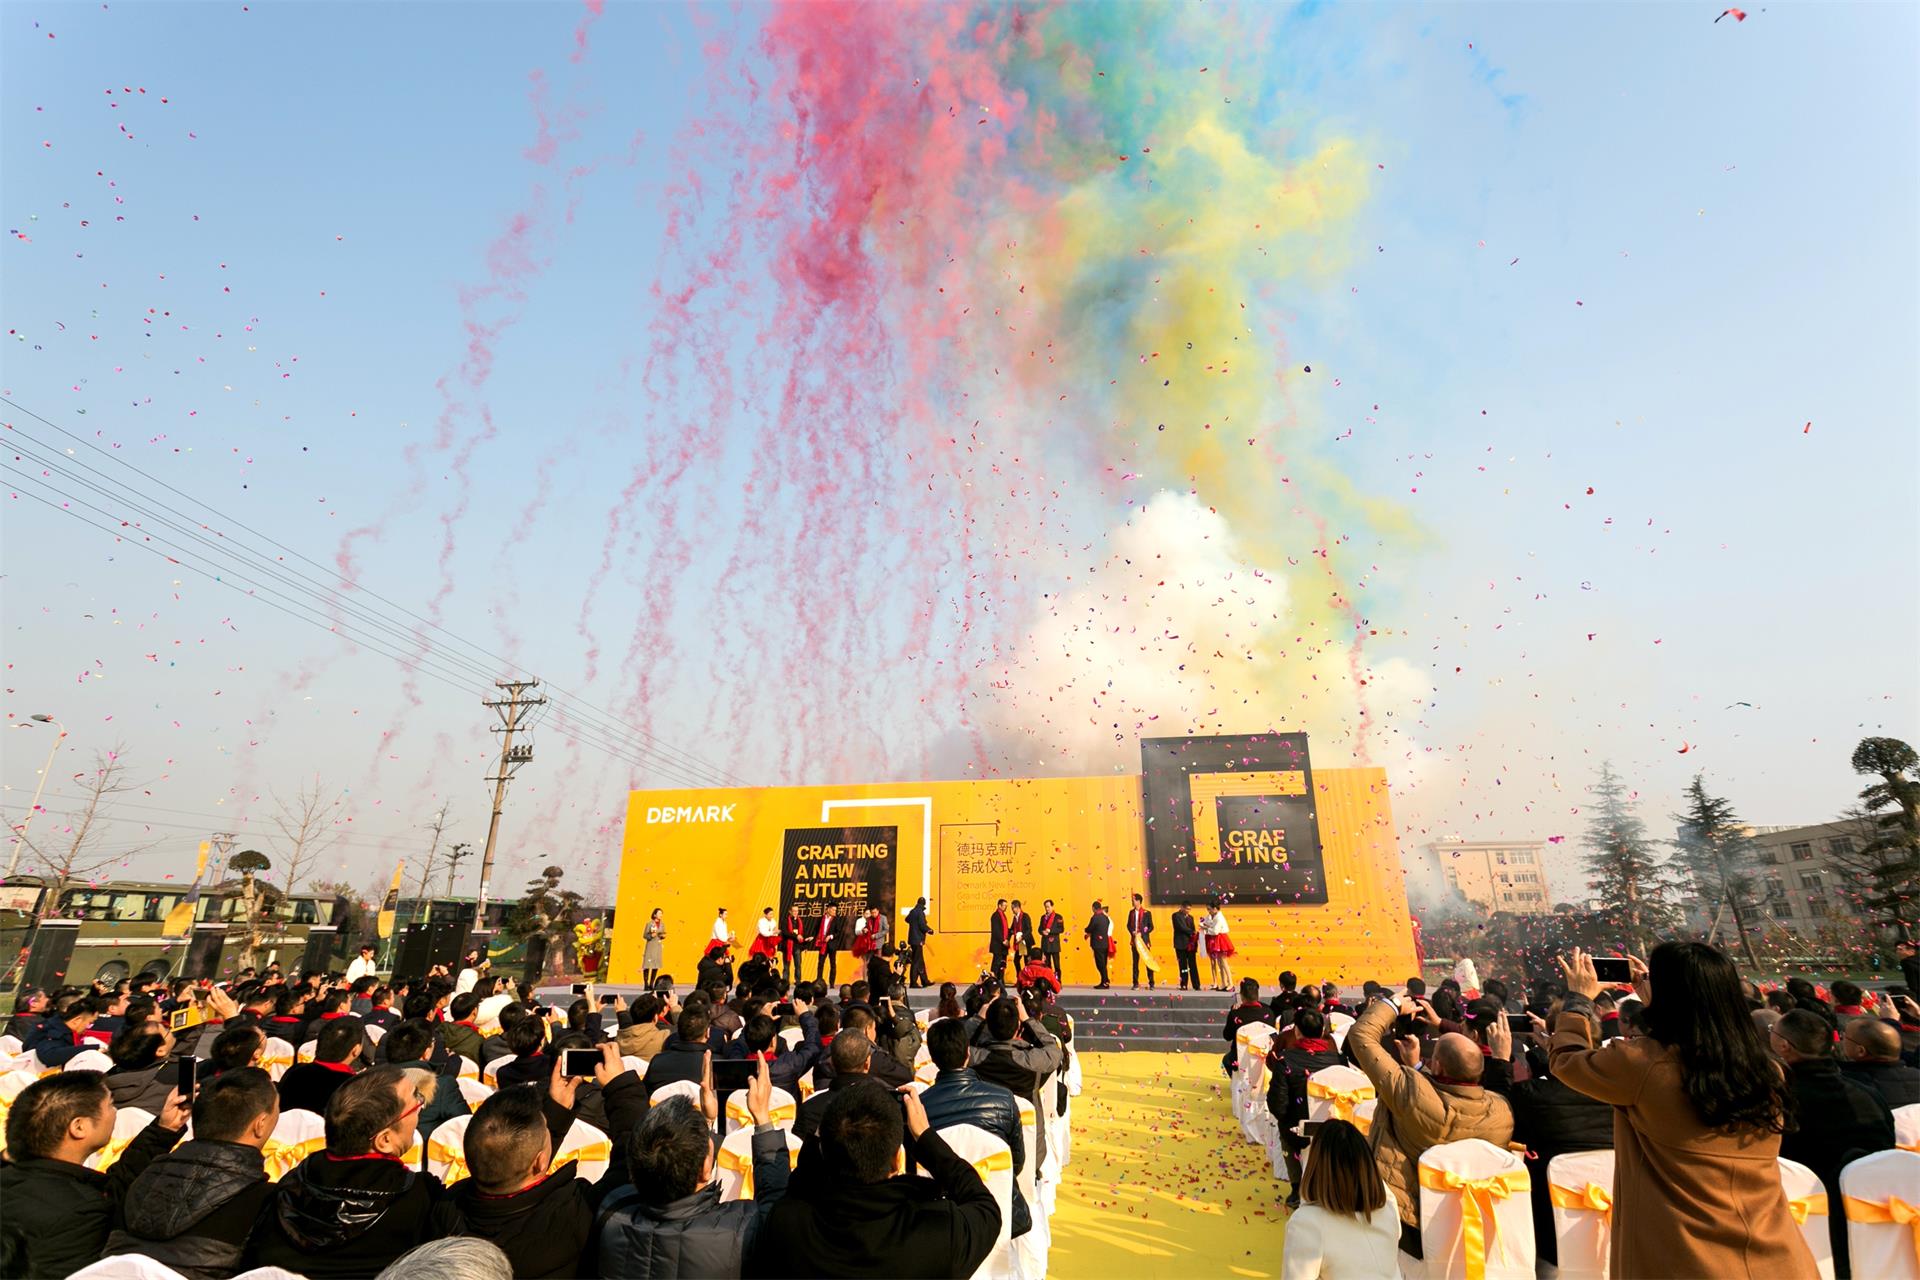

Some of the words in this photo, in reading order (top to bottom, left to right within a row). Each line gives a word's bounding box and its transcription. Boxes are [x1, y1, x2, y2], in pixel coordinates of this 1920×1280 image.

[646, 803, 737, 823] DEMARK
[1228, 829, 1285, 847] CRAF
[796, 843, 888, 860] CRAFTING
[957, 842, 1027, 857] 德玛克新厂
[1230, 846, 1288, 864] TING
[795, 863, 809, 879] A
[812, 863, 855, 879] NEW
[957, 859, 1014, 874] 落成仪式
[794, 882, 868, 899] FUTURE
[793, 901, 868, 918] 匠造新程
